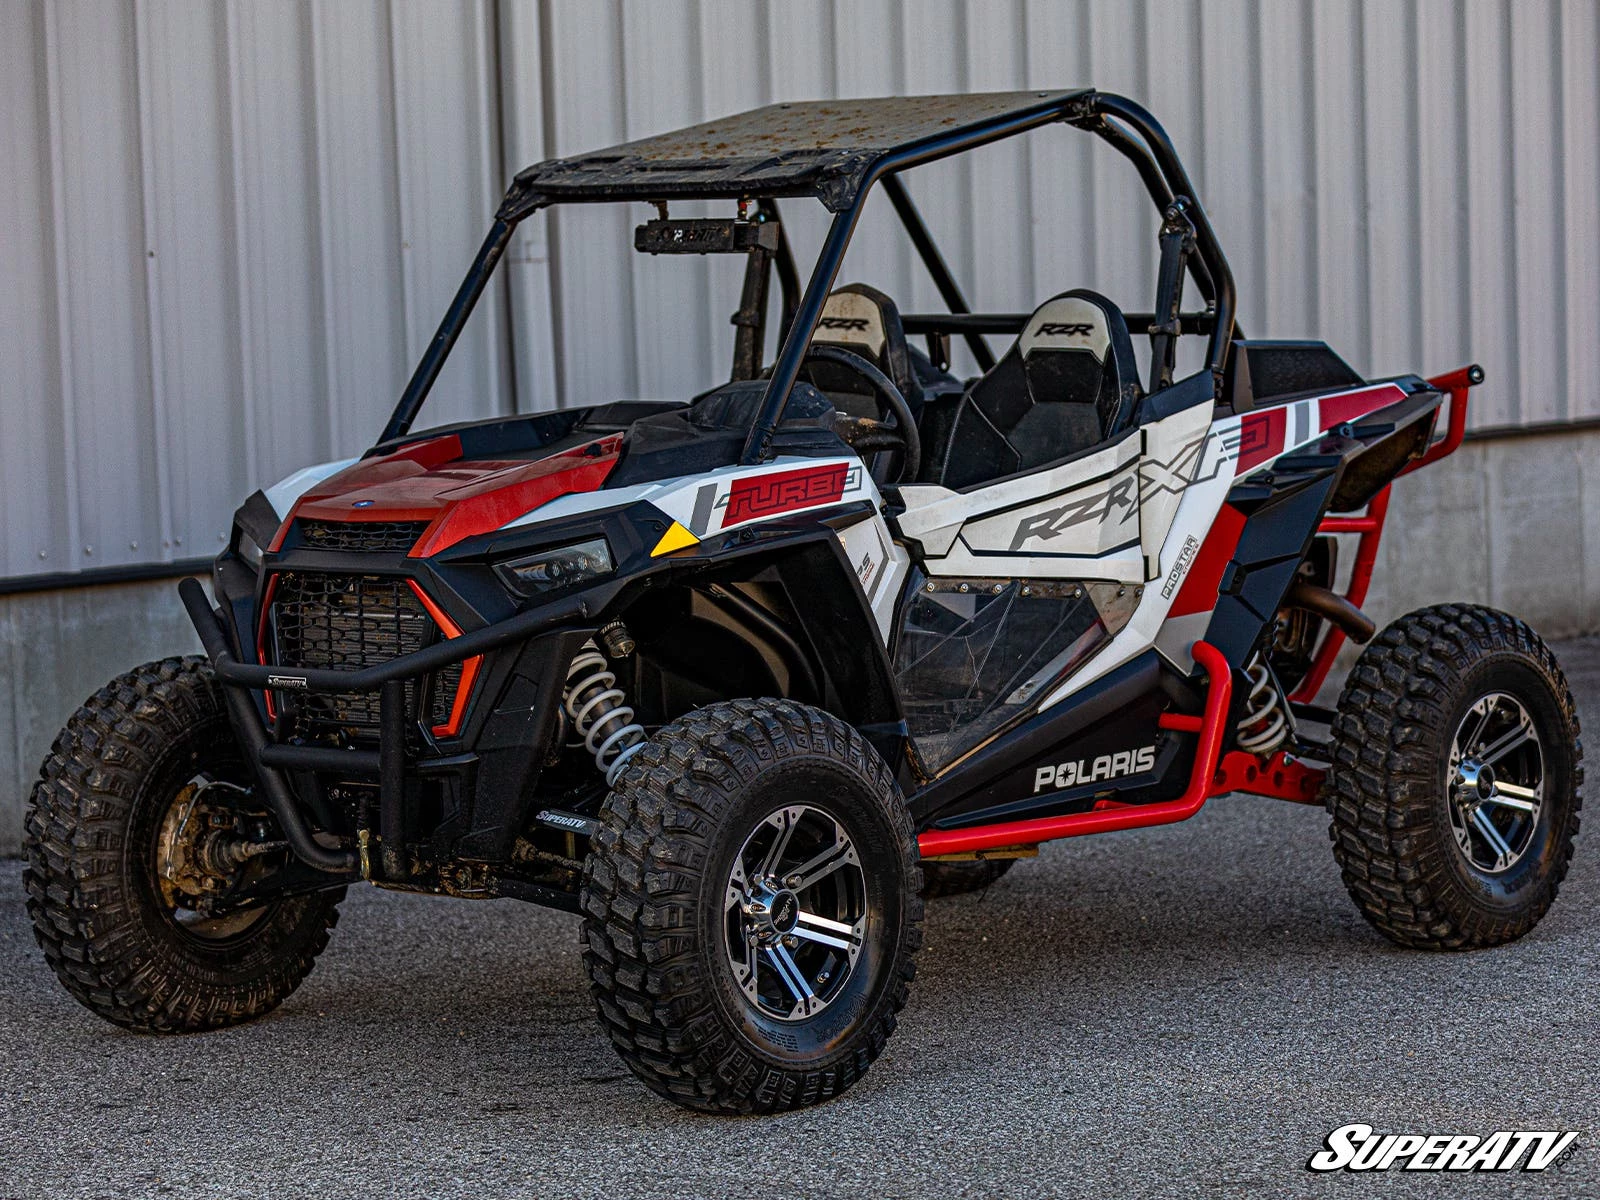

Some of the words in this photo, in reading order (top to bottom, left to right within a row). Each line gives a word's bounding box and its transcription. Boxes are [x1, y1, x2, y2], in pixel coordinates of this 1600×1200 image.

[816, 317, 870, 332] RZR
[1033, 323, 1095, 338] RZR
[713, 465, 863, 520] TURBO
[1008, 475, 1134, 551] RZR
[1118, 415, 1270, 526] XP
[1161, 534, 1198, 600] PROSTAR
[1033, 745, 1156, 793] POLARIS
